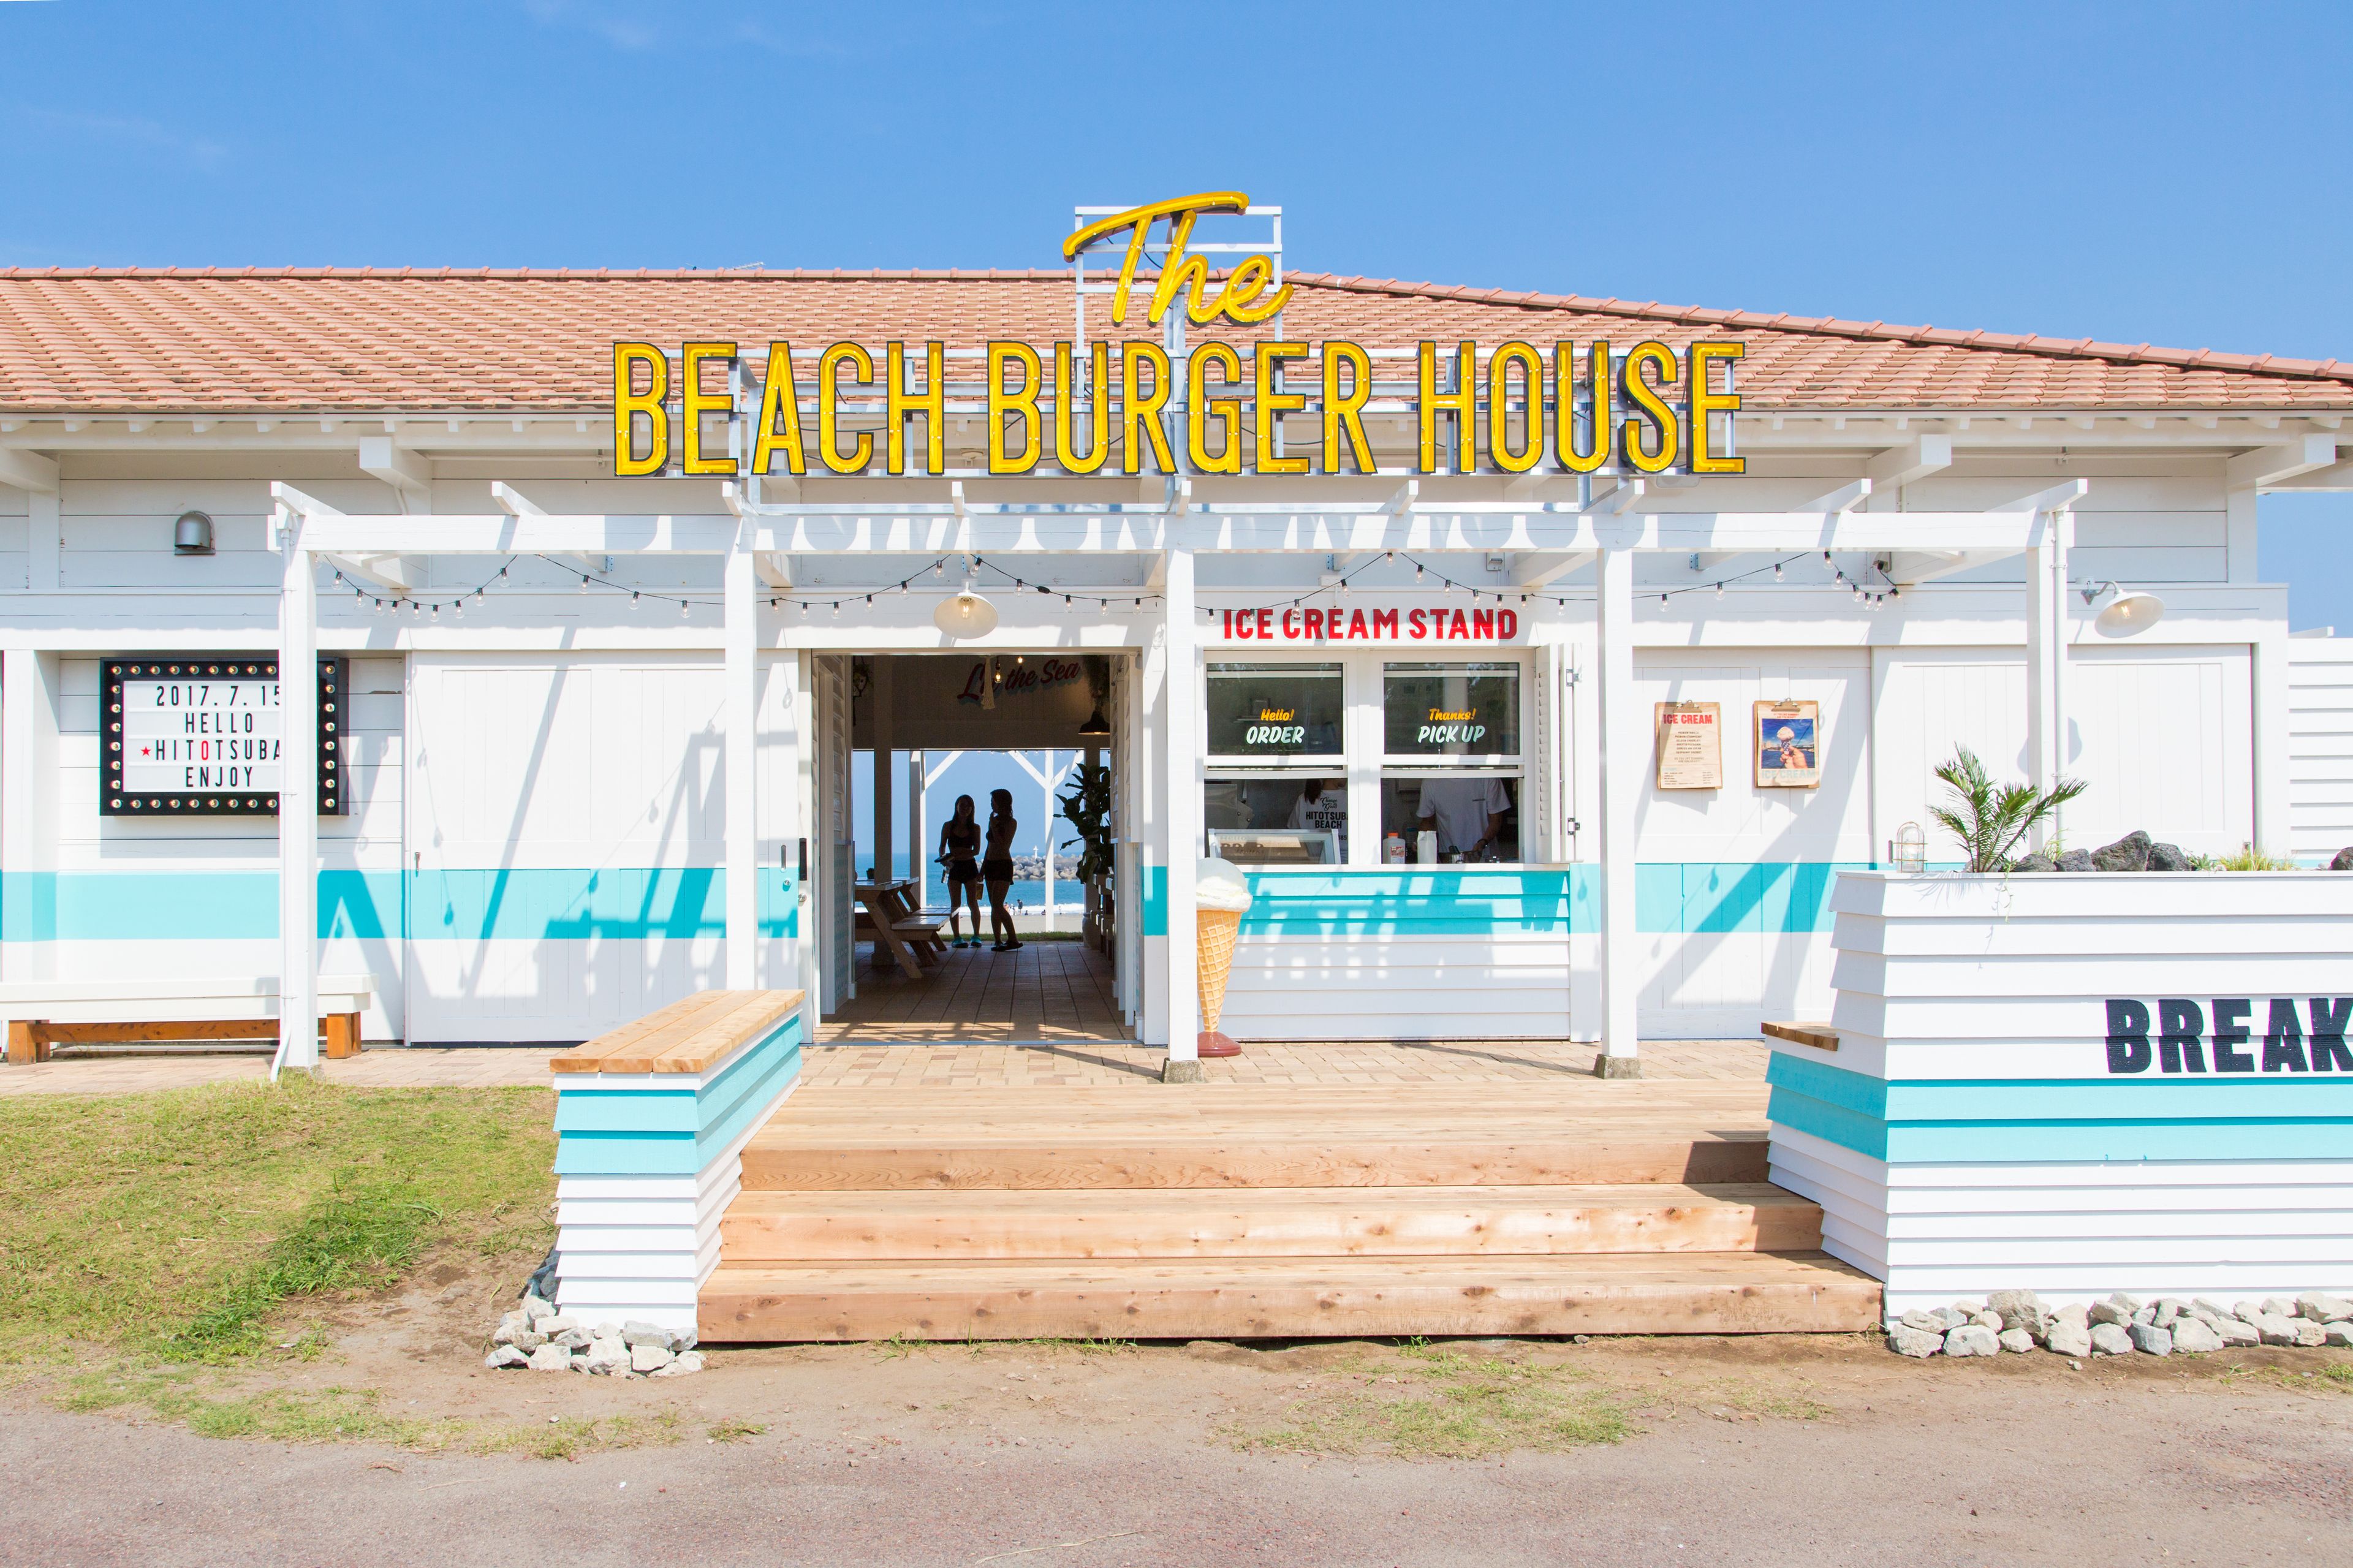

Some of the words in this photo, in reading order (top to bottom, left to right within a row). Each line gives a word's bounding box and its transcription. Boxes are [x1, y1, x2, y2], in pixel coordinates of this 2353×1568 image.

[1063, 191, 1294, 328] The
[613, 341, 945, 475] BEACH
[987, 341, 1377, 475] BURGER
[1418, 340, 1746, 474] HOUSE
[1224, 608, 1273, 640] ICE
[1283, 608, 1399, 640] CREAM
[1409, 608, 1518, 640] STAND
[1005, 665, 1038, 691] the
[1040, 659, 1081, 684] Sea
[186, 713, 252, 733] HELLO
[1260, 708, 1295, 721] Hello!
[1429, 708, 1476, 721] Thanks!
[1663, 714, 1678, 724] ICE
[1681, 714, 1713, 724] CREAM
[1246, 726, 1305, 744] ORDER
[1418, 725, 1458, 743] PICK
[1461, 725, 1485, 743] UP
[186, 767, 252, 787] ENJOY
[1762, 769, 1776, 779] ICE
[1779, 769, 1816, 779] CREAM
[1306, 811, 1347, 820] HITOTSUB
[1315, 820, 1342, 828] BEACH
[2105, 998, 2353, 1074] BREAK
